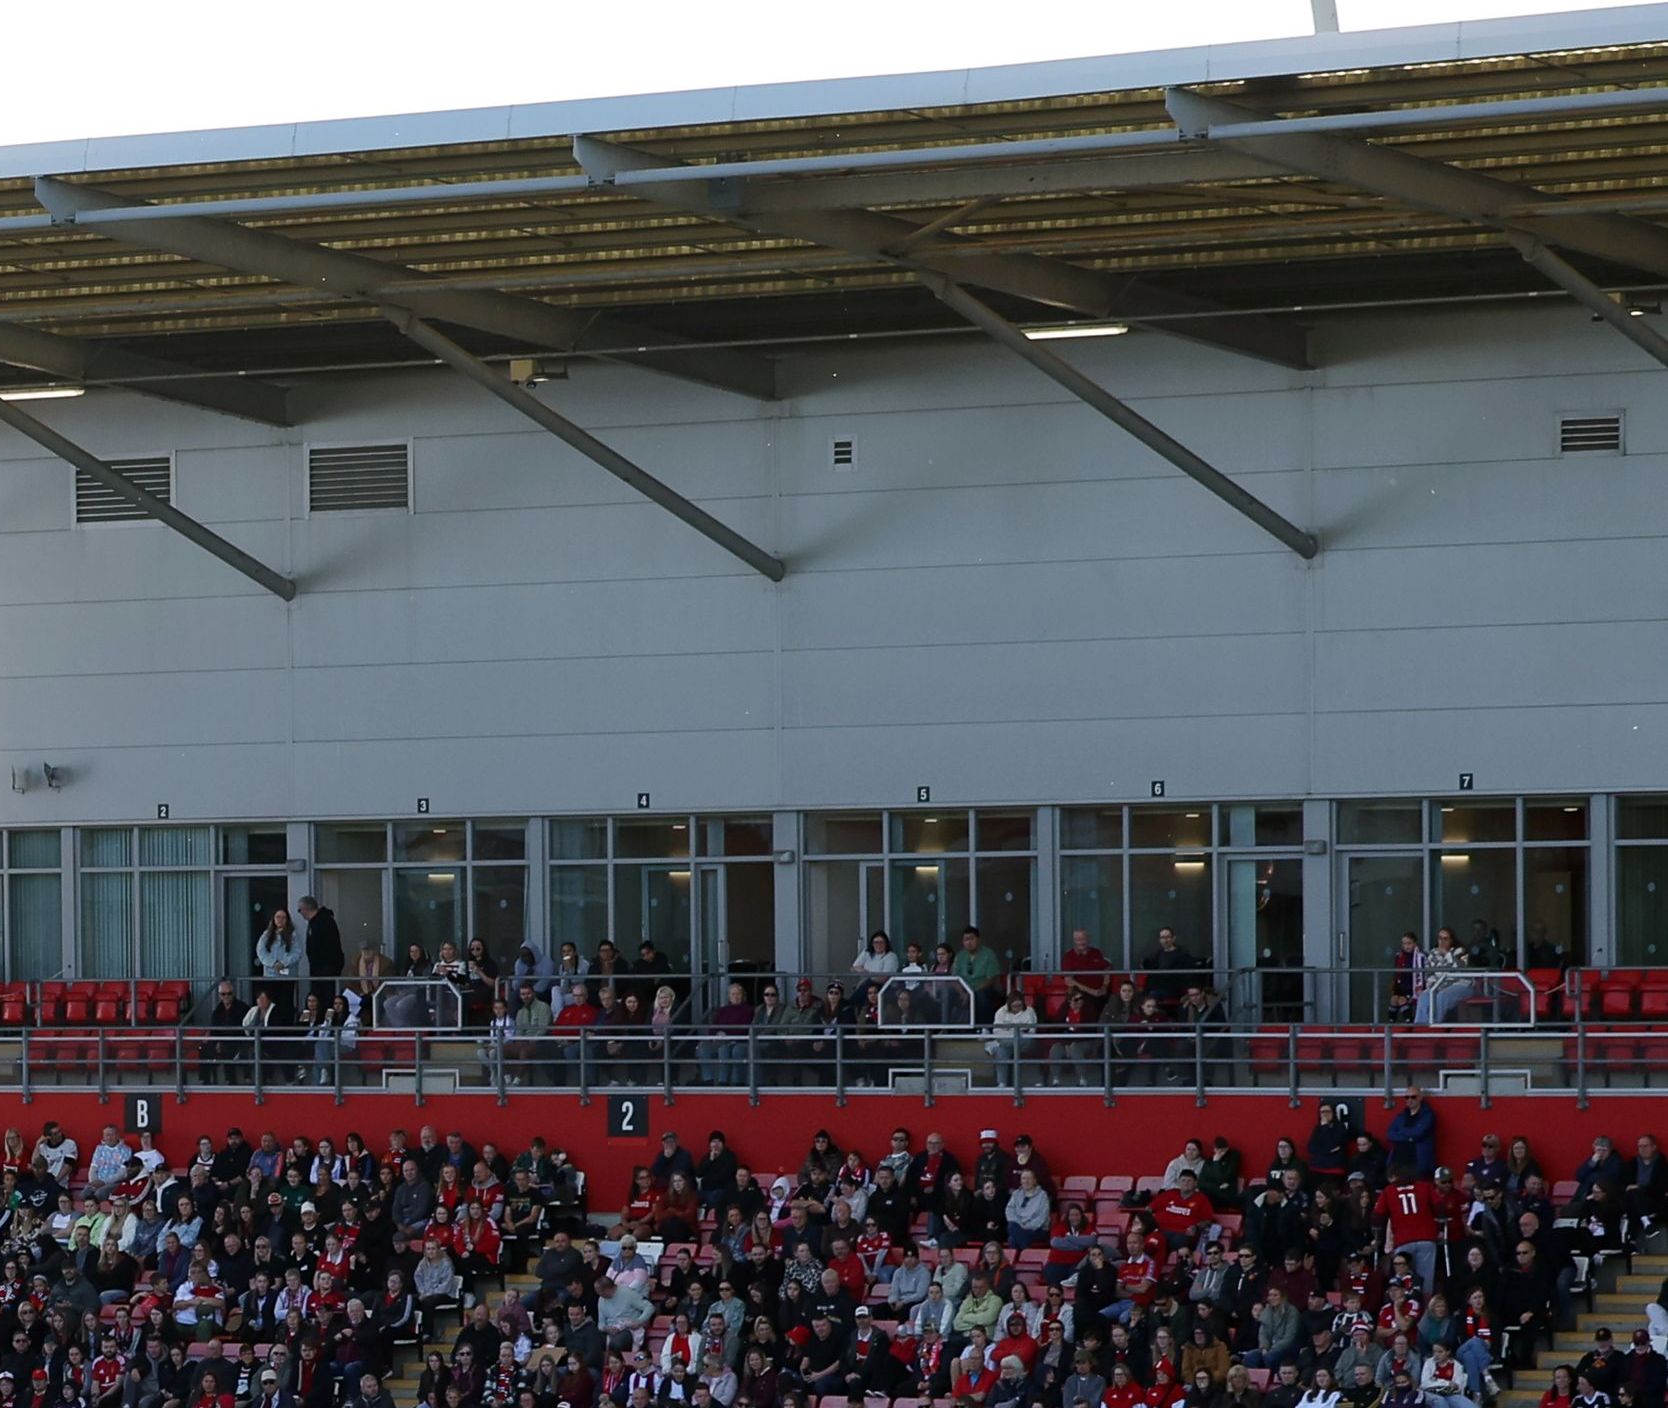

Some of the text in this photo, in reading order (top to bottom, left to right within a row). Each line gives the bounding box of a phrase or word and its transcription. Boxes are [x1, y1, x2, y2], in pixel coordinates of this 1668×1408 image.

[1462, 776, 1470, 787] 7
[1155, 783, 1162, 794] 6
[921, 789, 928, 800] 5
[421, 801, 427, 811] 3
[640, 795, 648, 806] 4
[160, 806, 167, 817] 2
[136, 1099, 149, 1128] B
[621, 1101, 634, 1131] 2
